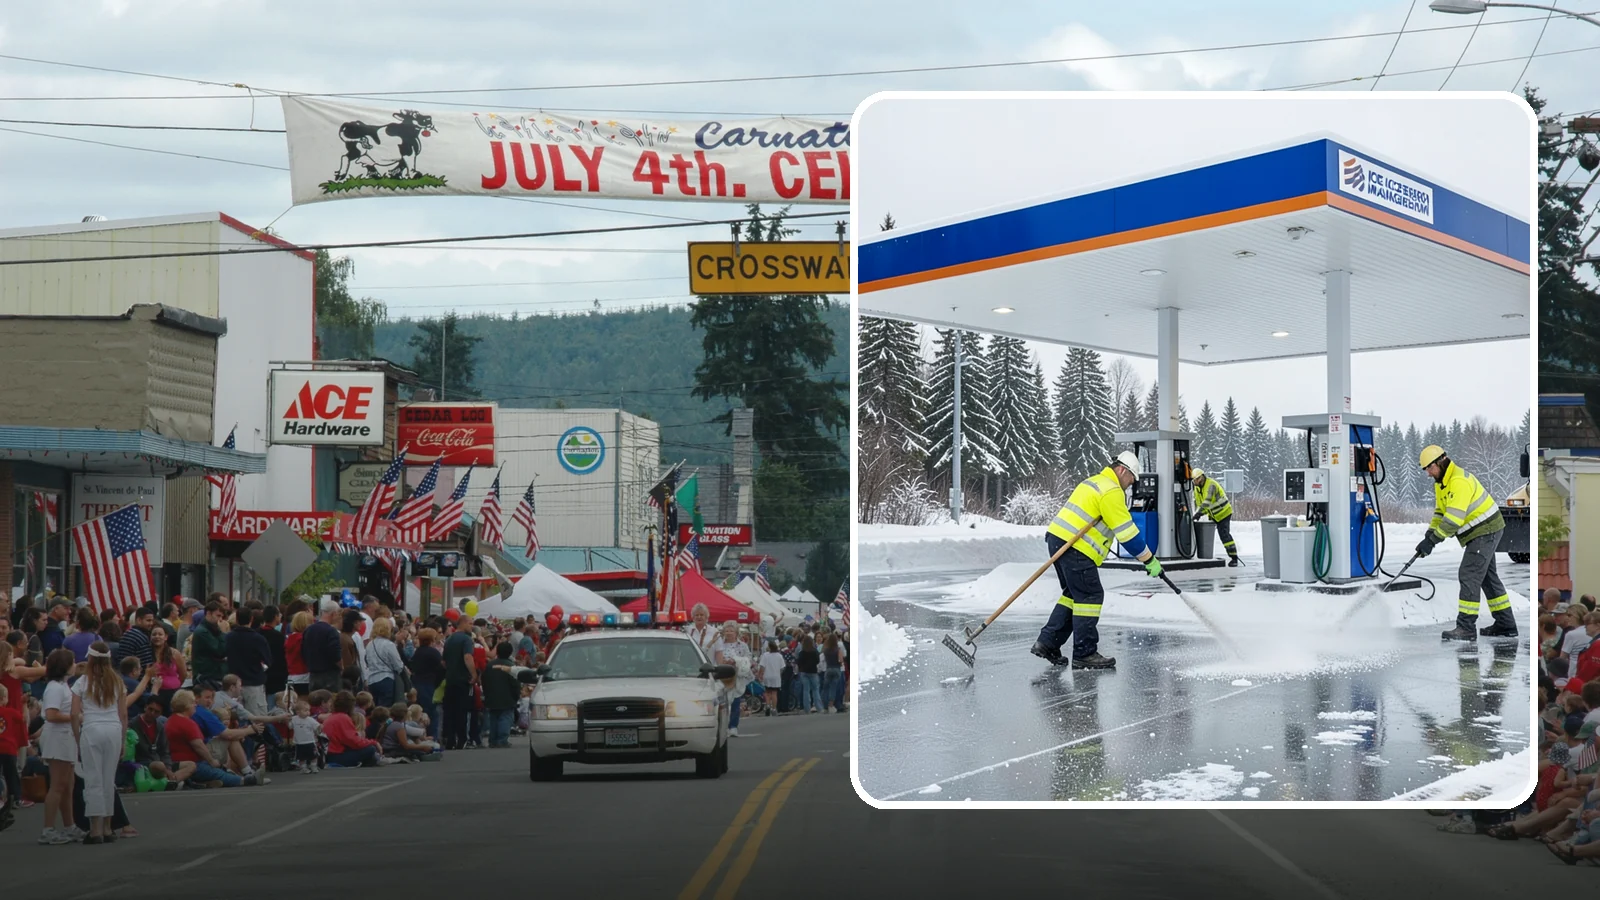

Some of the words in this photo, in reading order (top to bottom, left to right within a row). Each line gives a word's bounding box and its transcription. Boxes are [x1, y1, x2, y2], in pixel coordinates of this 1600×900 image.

[481, 140, 604, 192] JULY
[632, 149, 747, 197] 4th.
[696, 254, 850, 281] CROSSWA
[282, 380, 373, 420] ACE
[405, 409, 452, 421] CEDAR
[284, 421, 370, 436] Hardware
[416, 428, 477, 447] Coca-Cola
[353, 467, 385, 479] Simpl
[84, 486, 94, 494] St.
[95, 485, 124, 494] Vincent
[126, 485, 135, 494] de
[138, 485, 155, 495] Paul
[213, 515, 331, 535] HARDARE
[688, 526, 741, 535] CRNATION
[699, 535, 731, 543] GLASS
